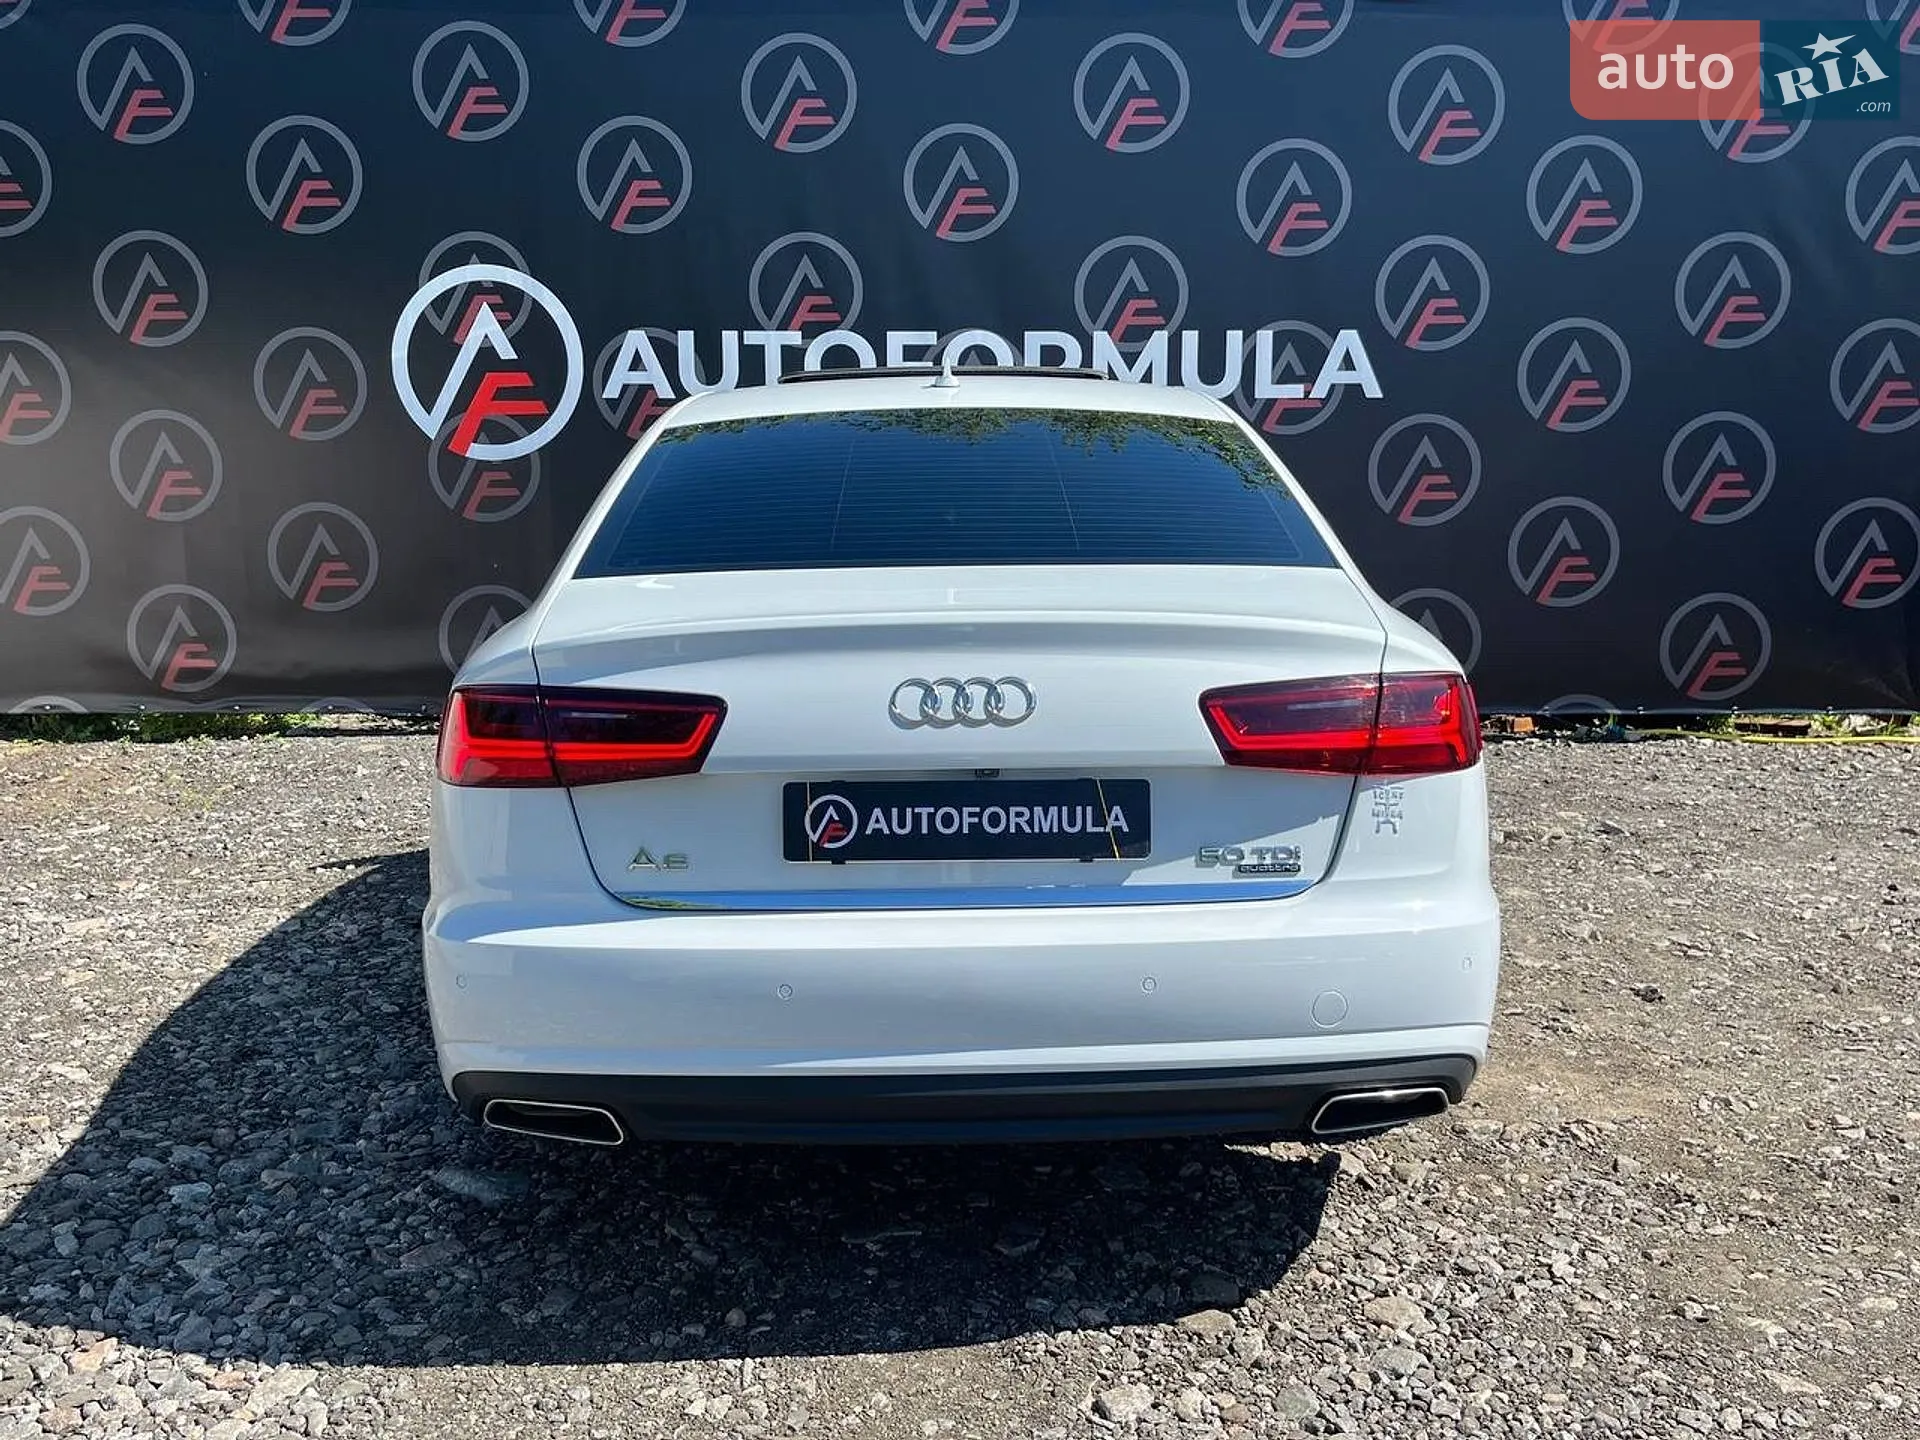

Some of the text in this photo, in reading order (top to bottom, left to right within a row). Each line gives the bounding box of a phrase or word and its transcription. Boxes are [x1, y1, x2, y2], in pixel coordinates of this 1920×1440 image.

[601, 328, 1384, 399] AUTOFORMULA
[865, 804, 1130, 835] AUTOFORMULA
[1239, 865, 1300, 874] quattro
